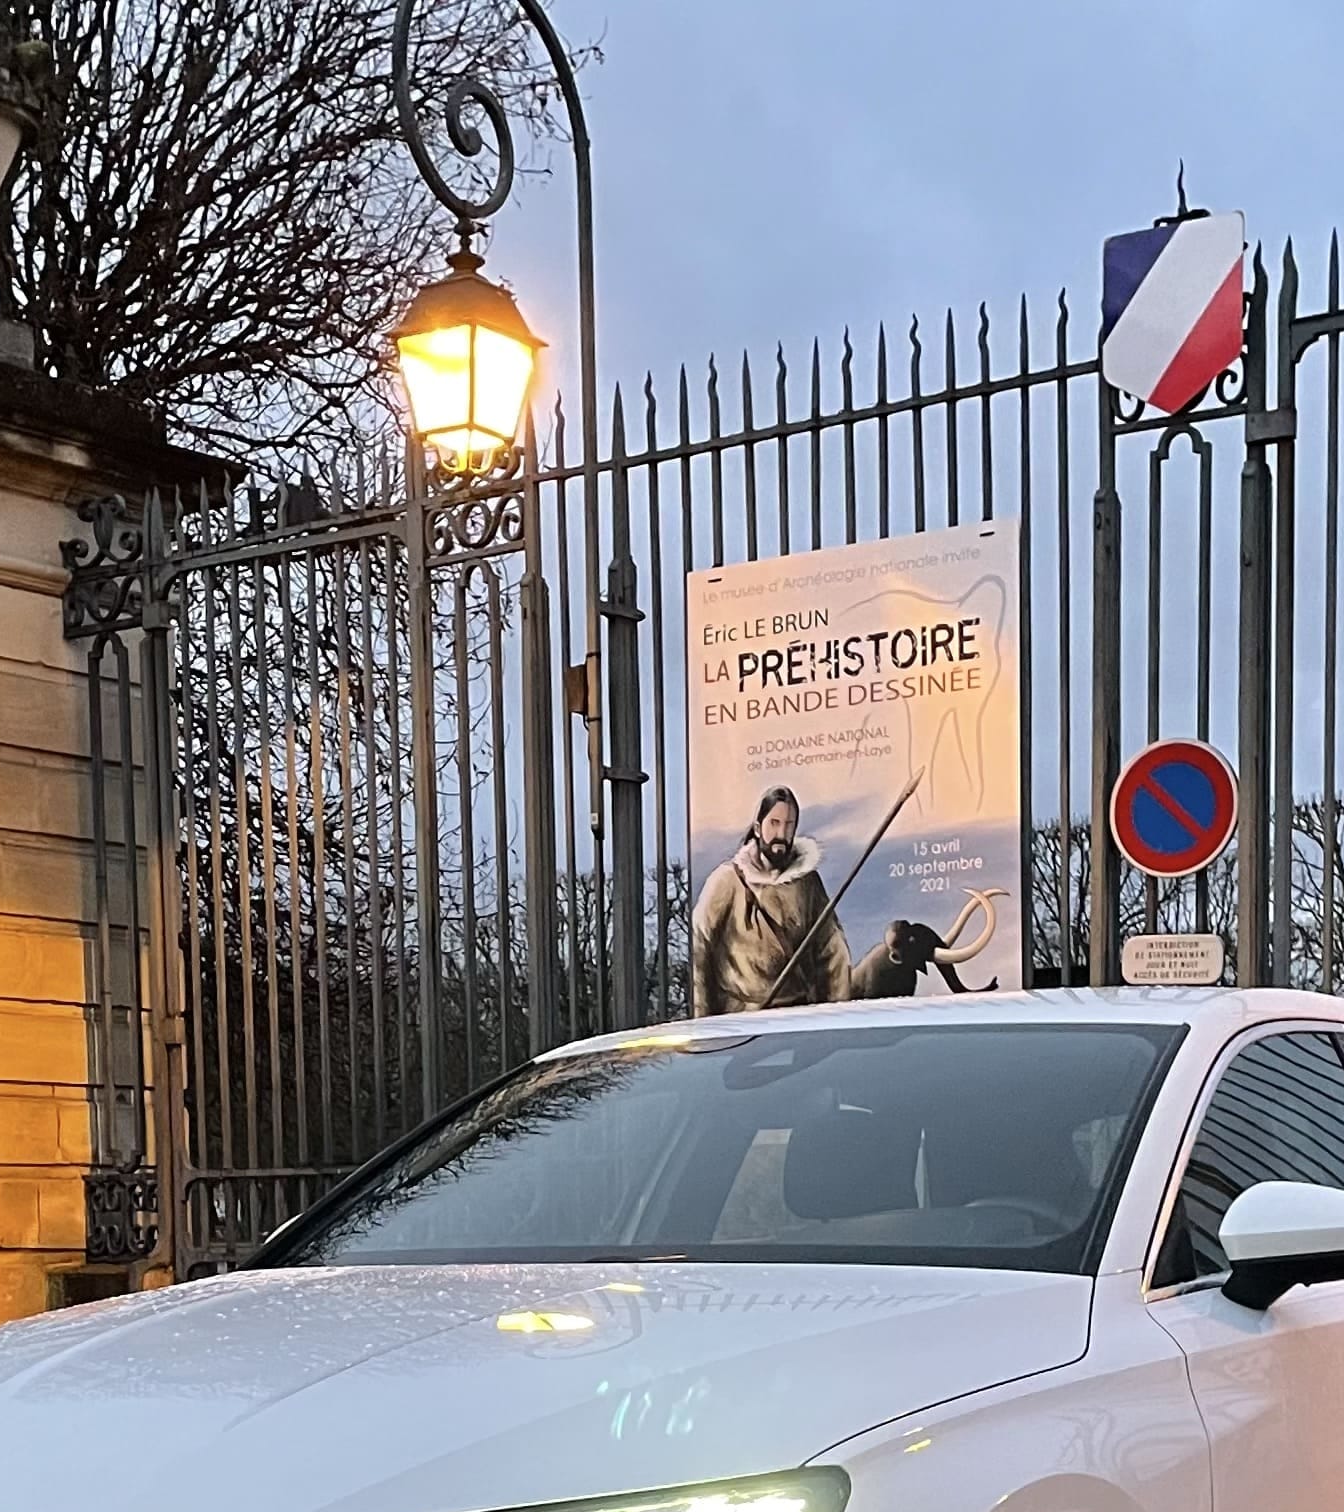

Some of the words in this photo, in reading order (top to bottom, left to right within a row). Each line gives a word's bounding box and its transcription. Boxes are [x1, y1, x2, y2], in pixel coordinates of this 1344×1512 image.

[871, 553, 938, 576] nationale
[942, 547, 981, 563] invite
[703, 624, 737, 645] Éric
[744, 618, 766, 638] LE
[772, 608, 828, 634] BRUN
[704, 659, 730, 683] LA
[738, 617, 981, 692] PRÉHISTOIRE
[704, 702, 736, 725] EN
[747, 687, 839, 719] BANDE
[848, 666, 982, 706] DESSINÉE
[747, 745, 762, 756] au
[765, 734, 825, 753] DOMAINE
[828, 726, 890, 743] NATIONAL
[747, 761, 762, 772] de
[913, 841, 928, 856] 15
[931, 838, 960, 854] avril
[889, 863, 905, 877] 20
[908, 857, 983, 877] septembre
[920, 877, 951, 893] 2021
